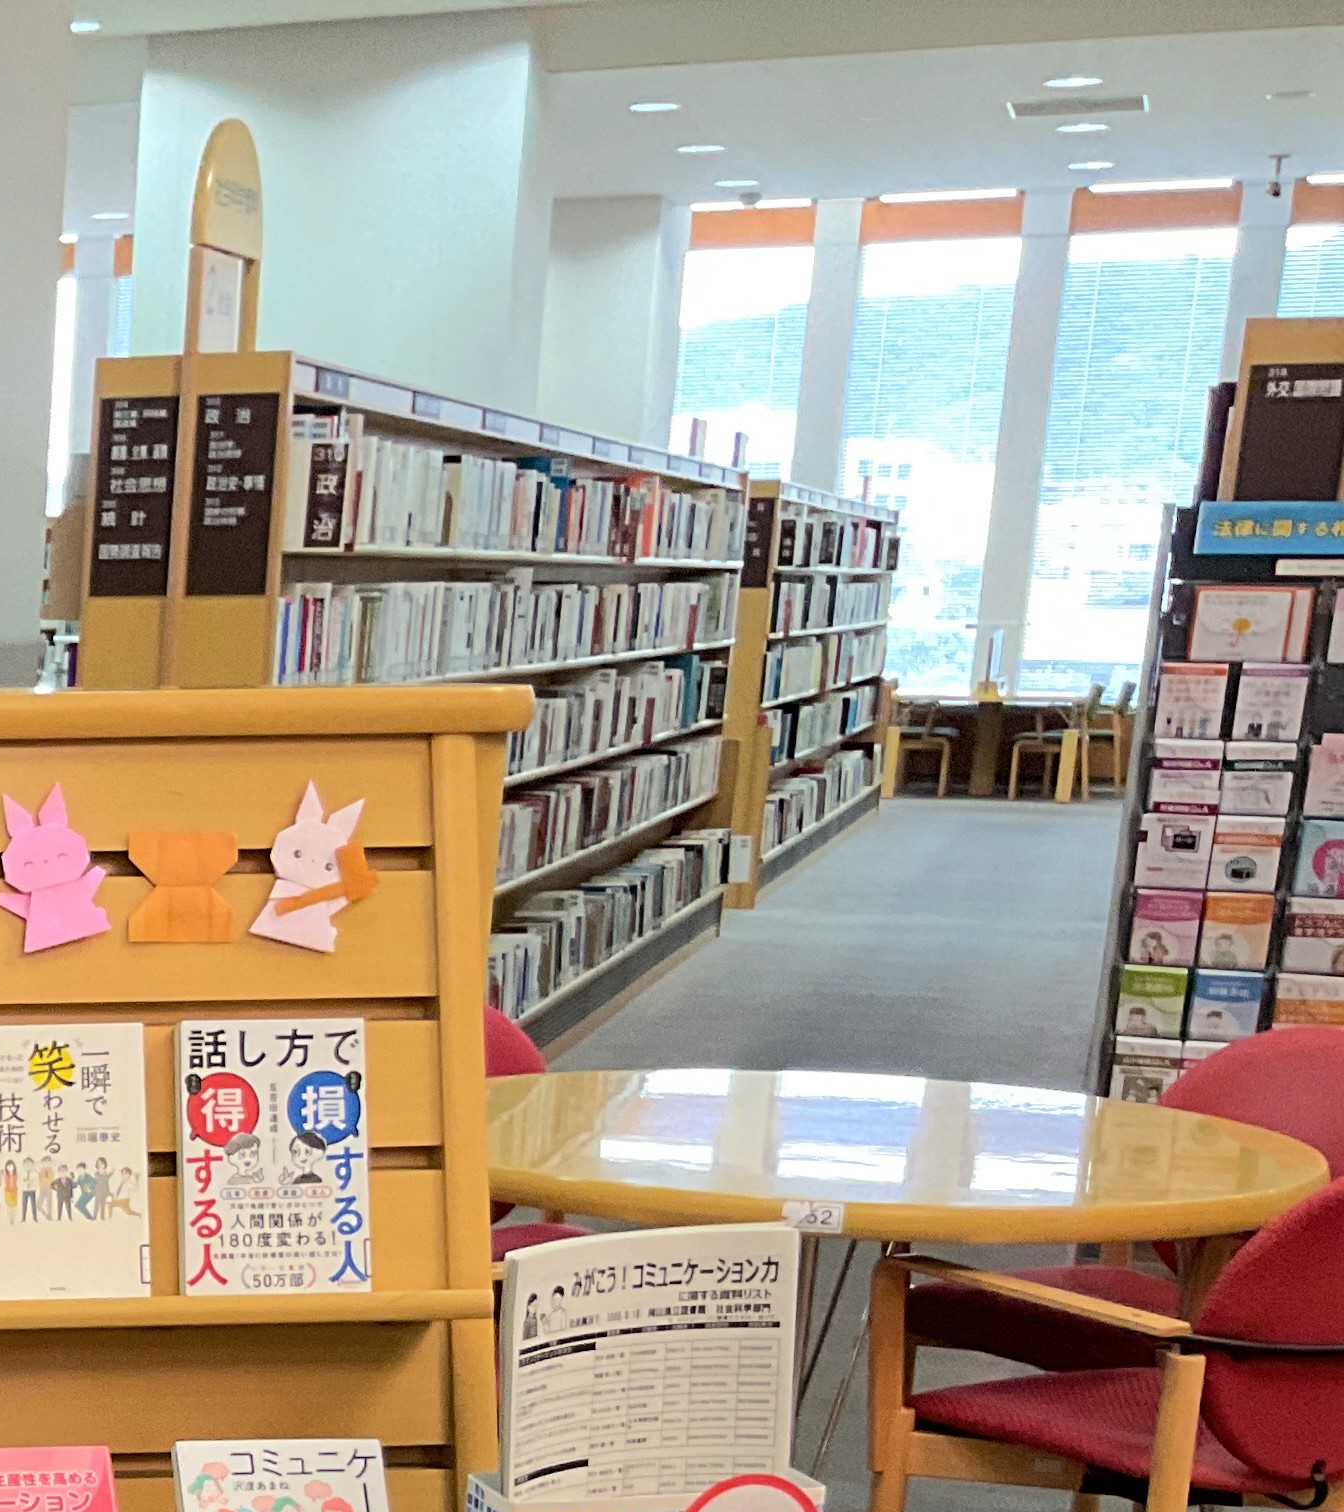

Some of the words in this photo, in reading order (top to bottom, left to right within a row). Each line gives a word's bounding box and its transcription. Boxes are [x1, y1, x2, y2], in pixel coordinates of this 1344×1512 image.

[187, 1028, 360, 1069] 話し方で
[27, 1040, 77, 1155] 笑わせる
[79, 1049, 114, 1116] 一瞬で
[185, 1086, 246, 1288] 得する人
[301, 1085, 368, 1284] 損する人
[229, 1211, 324, 1230] 人間関係が
[251, 1273, 305, 1289] 50万部
